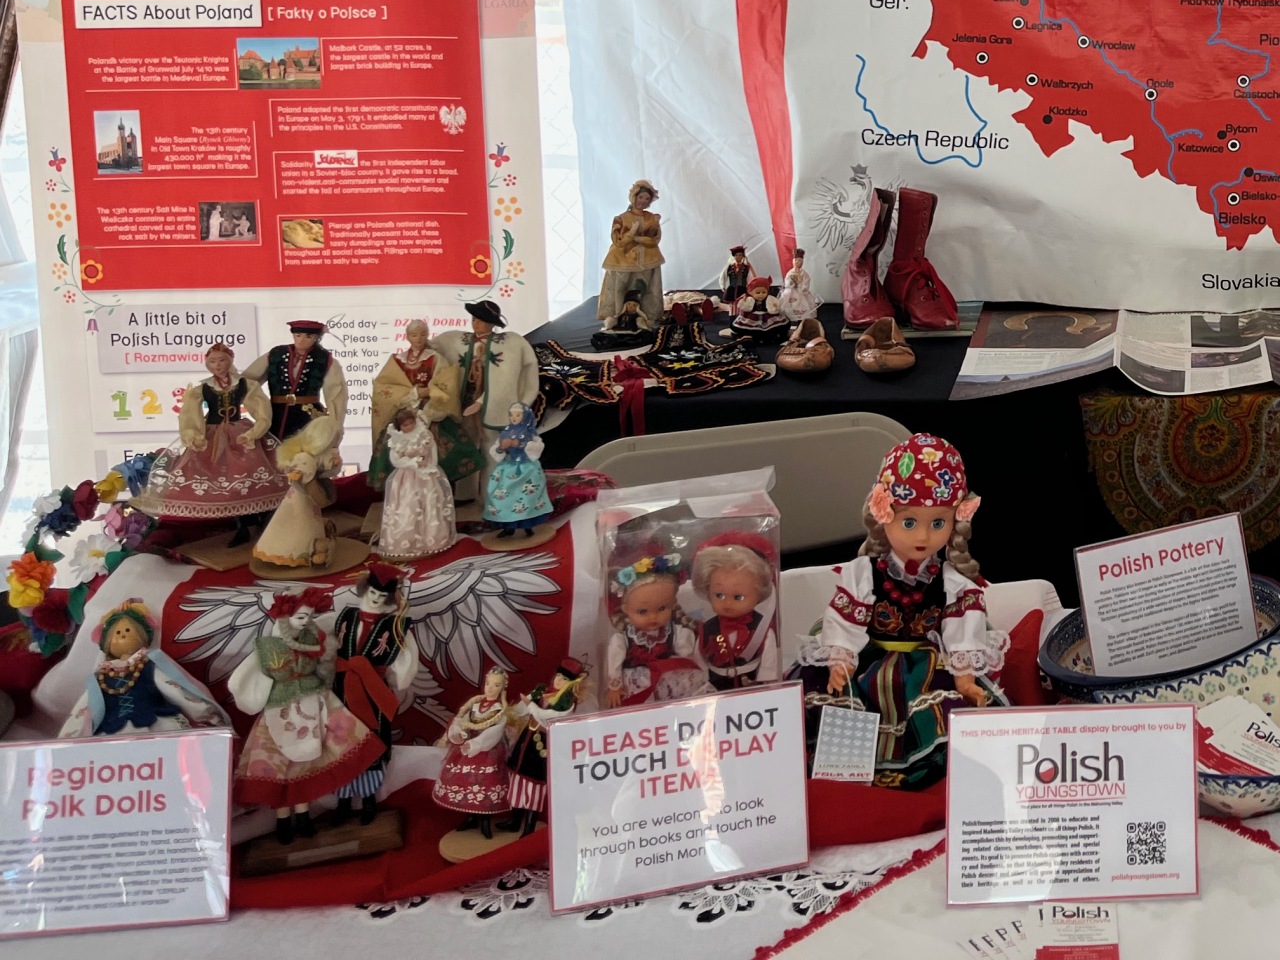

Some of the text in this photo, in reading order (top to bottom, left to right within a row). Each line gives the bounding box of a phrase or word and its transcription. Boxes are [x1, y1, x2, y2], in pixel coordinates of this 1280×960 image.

[82, 3, 254, 23] FACTS About Poland
[276, 5, 377, 23] Fakty Polsce
[861, 129, 1009, 152] Czech Republic
[1219, 212, 1266, 225] Bielsko
[1202, 274, 1280, 291] Slovakia
[128, 311, 227, 328] A little bit of
[358, 319, 377, 329] day
[433, 318, 469, 327] DOBRY
[111, 332, 160, 347] Polish
[343, 334, 378, 343] Please
[362, 348, 379, 357] You
[1099, 536, 1225, 581] Polish Pottery
[571, 708, 779, 760] PLEASE NOT
[981, 729, 1009, 737] POLISH
[1011, 727, 1051, 736] HERITAGE
[1053, 726, 1077, 734] TABLE
[1080, 725, 1109, 735] display
[1112, 723, 1146, 734] brought
[1159, 722, 1174, 732] you
[1176, 722, 1186, 732] by
[574, 751, 667, 784] TOUCH
[1017, 741, 1125, 785] Polish
[27, 757, 164, 790] Regional
[1016, 783, 1125, 799] YOUNGSTOWN
[96, 790, 167, 816] Dolls
[735, 798, 764, 812] look
[580, 814, 776, 859] through books touch the
[635, 851, 673, 868] Polish
[1052, 905, 1109, 918] Polish
